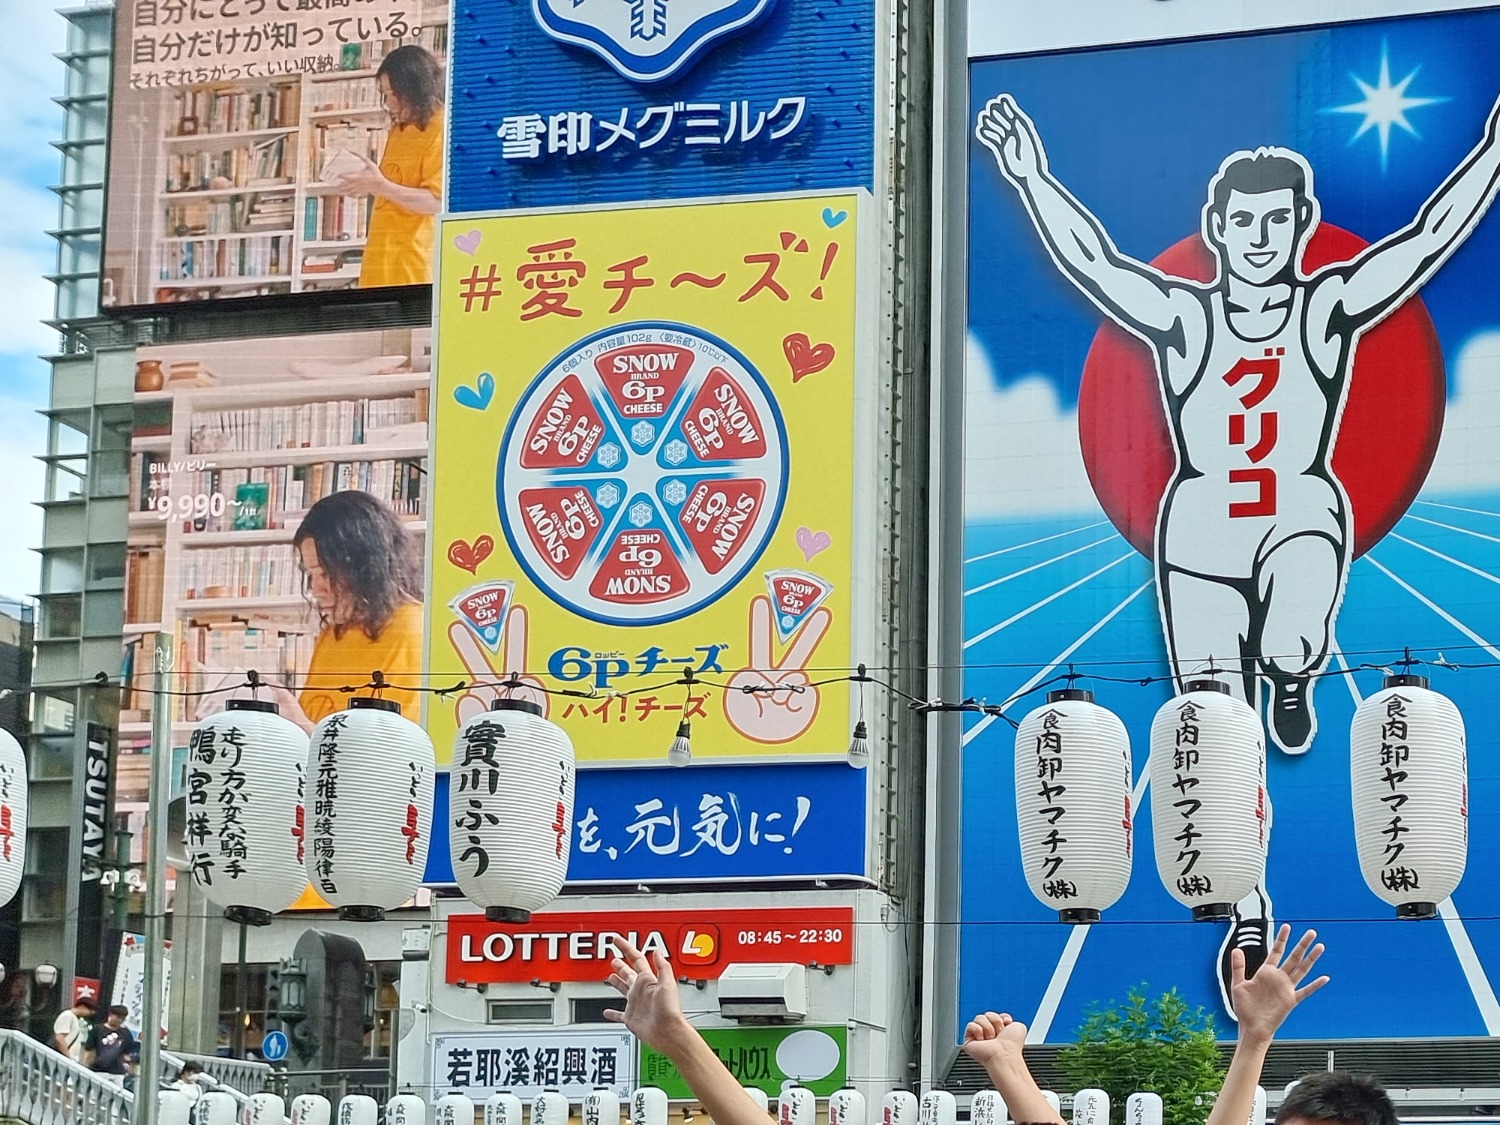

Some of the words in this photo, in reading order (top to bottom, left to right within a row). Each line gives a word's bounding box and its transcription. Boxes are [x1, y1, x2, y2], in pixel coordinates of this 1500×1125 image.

[132, 11, 422, 64] 自分だけが知っている。
[129, 55, 340, 89] それぞれちがって、いい収納。
[497, 97, 807, 160] 雪印メグミルク
[612, 352, 679, 374] SNOW
[530, 387, 575, 456] SNOW
[623, 403, 663, 415] CHEESE
[714, 383, 760, 446] SNOW
[576, 424, 602, 463] CHEESE
[684, 419, 711, 458] CHEESE
[1222, 347, 1286, 518] グリコ
[574, 489, 600, 528] CHEESE
[682, 484, 709, 523] CHEESE
[526, 503, 571, 565] SNOW
[620, 533, 660, 545] CHEESE
[711, 492, 756, 562] SNOW
[467, 590, 499, 610] SNOW
[605, 575, 671, 596] SNOW
[781, 579, 815, 596] SNOW
[81, 740, 109, 882] TSUTAYA
[182, 725, 217, 887] 鴨宮祥行
[218, 726, 253, 879] 走り方が変な騎手
[456, 720, 507, 878] 實川ふう
[461, 931, 669, 962] LOTTERIA
[447, 1047, 618, 1087] 若耶溪紹興酒
